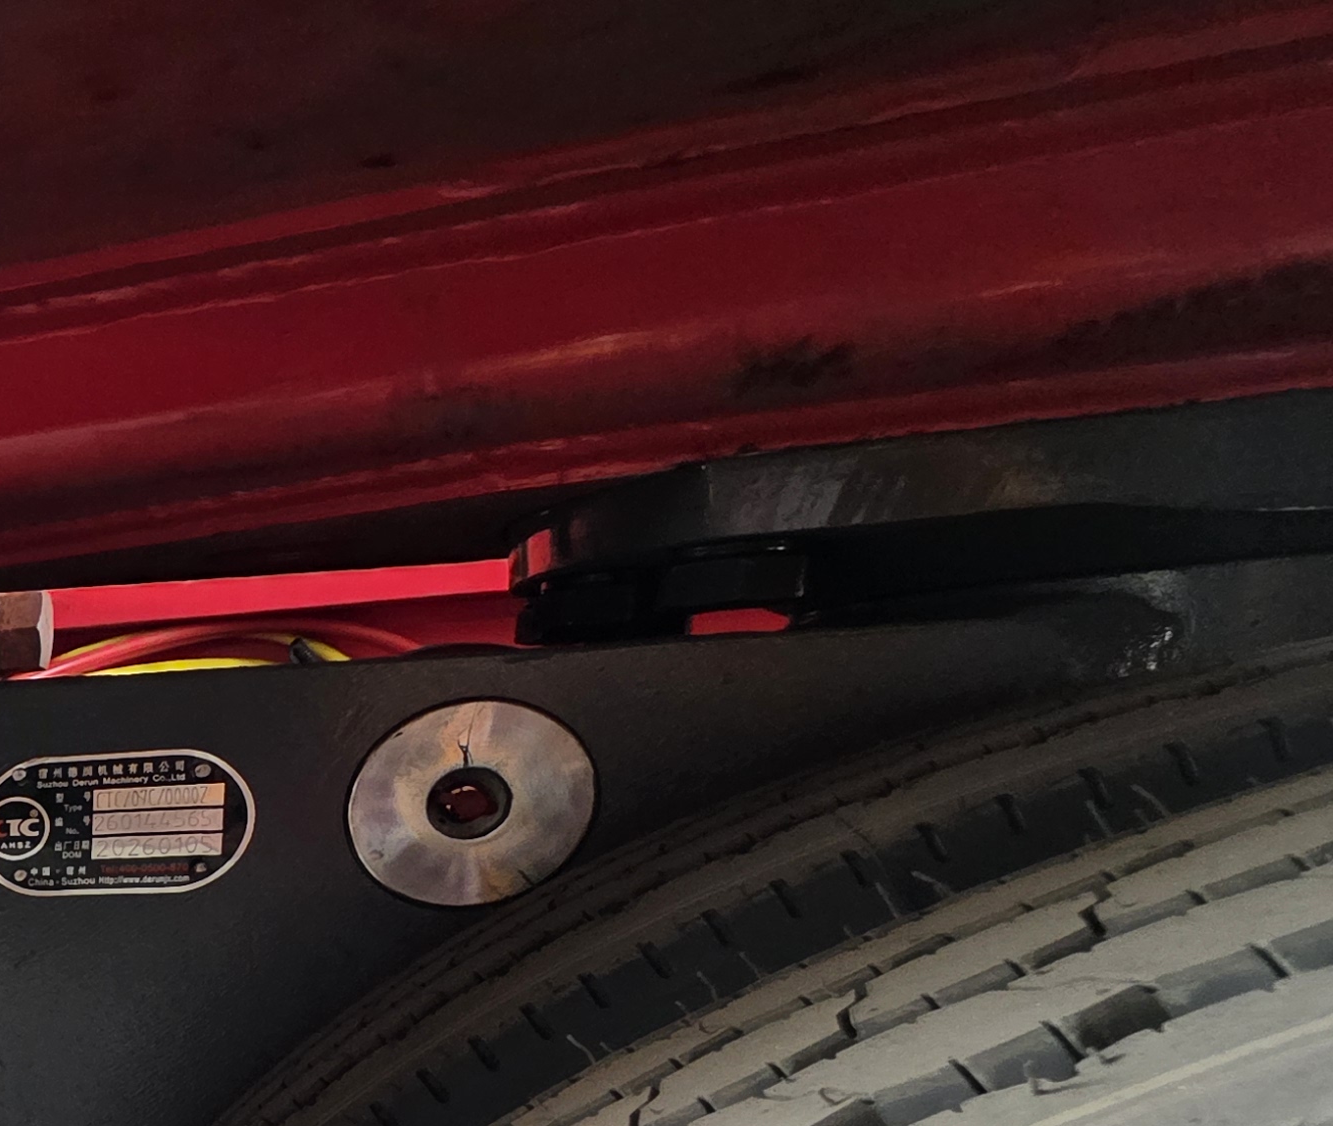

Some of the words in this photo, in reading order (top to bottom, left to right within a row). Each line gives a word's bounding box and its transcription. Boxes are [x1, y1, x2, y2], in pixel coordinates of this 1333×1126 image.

[36, 780, 69, 790] Suzhou
[72, 777, 99, 787] Derun
[103, 774, 148, 786] Machinery
[64, 803, 83, 813] Type
[28, 876, 54, 887] China
[61, 875, 95, 886] Suzhou
